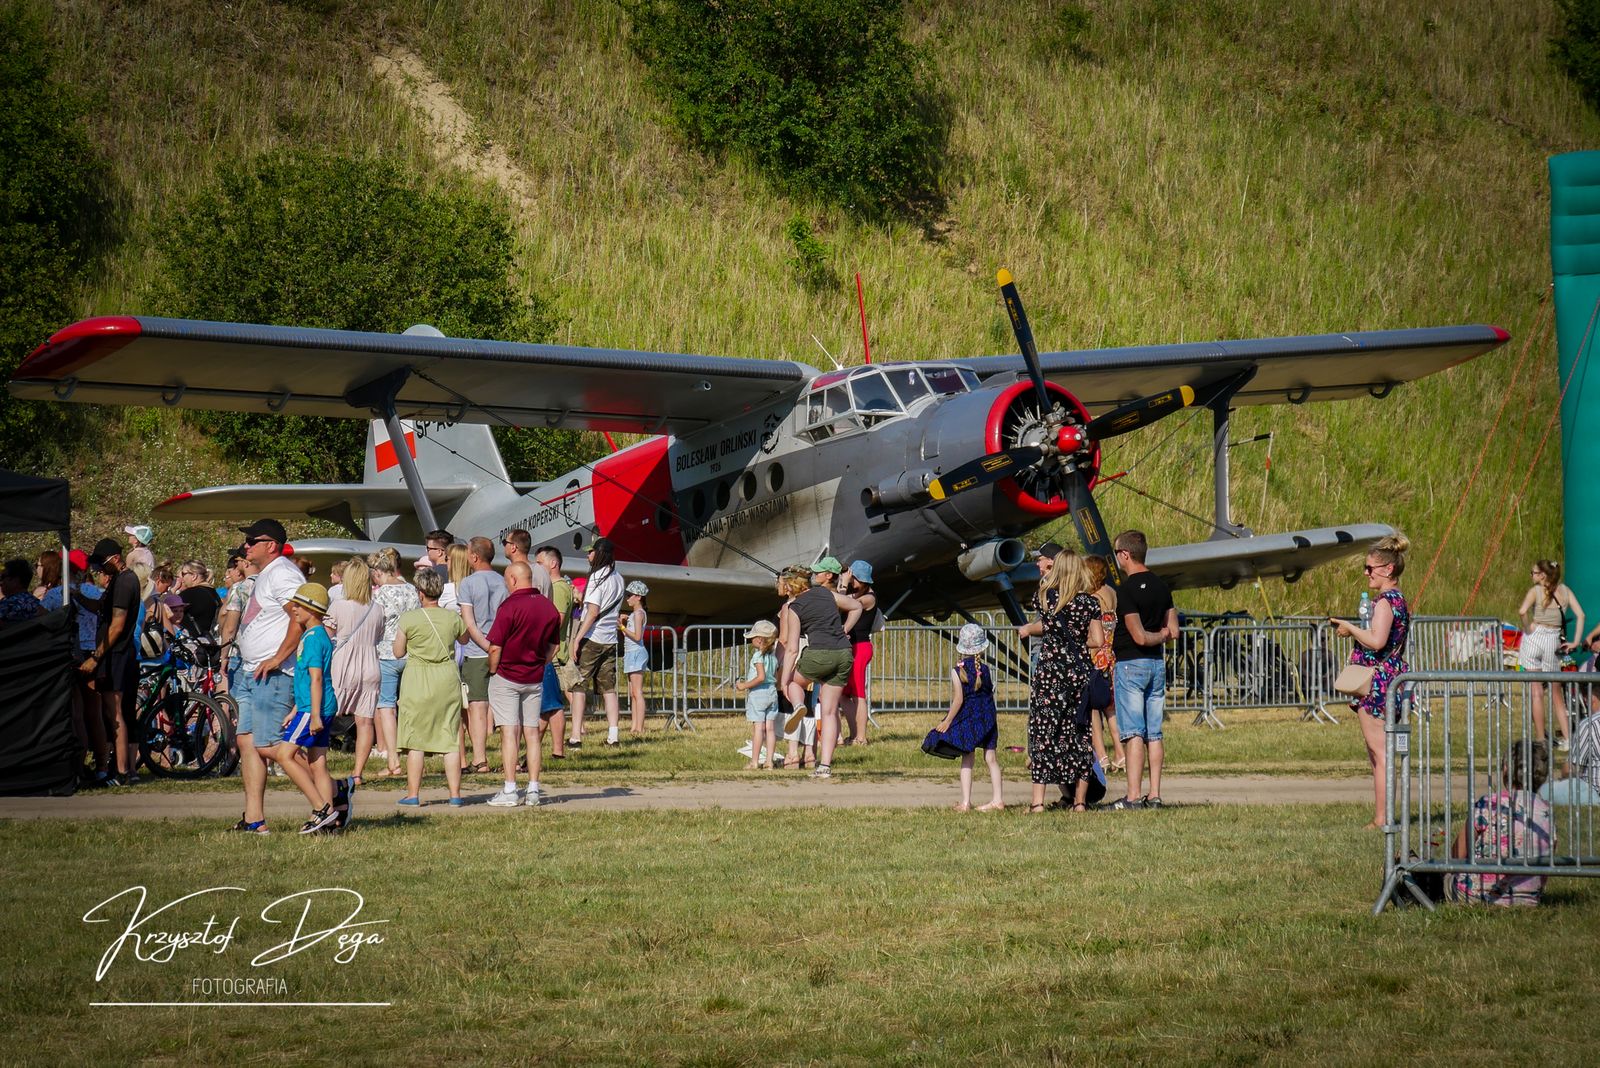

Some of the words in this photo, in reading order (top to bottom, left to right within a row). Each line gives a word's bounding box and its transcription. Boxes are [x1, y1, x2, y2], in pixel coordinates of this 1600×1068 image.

[676, 443, 718, 472] BOLESŁAW
[720, 429, 757, 457] ORLIŃSKI
[710, 461, 722, 475] 1926
[528, 503, 560, 532] KOPERSKI
